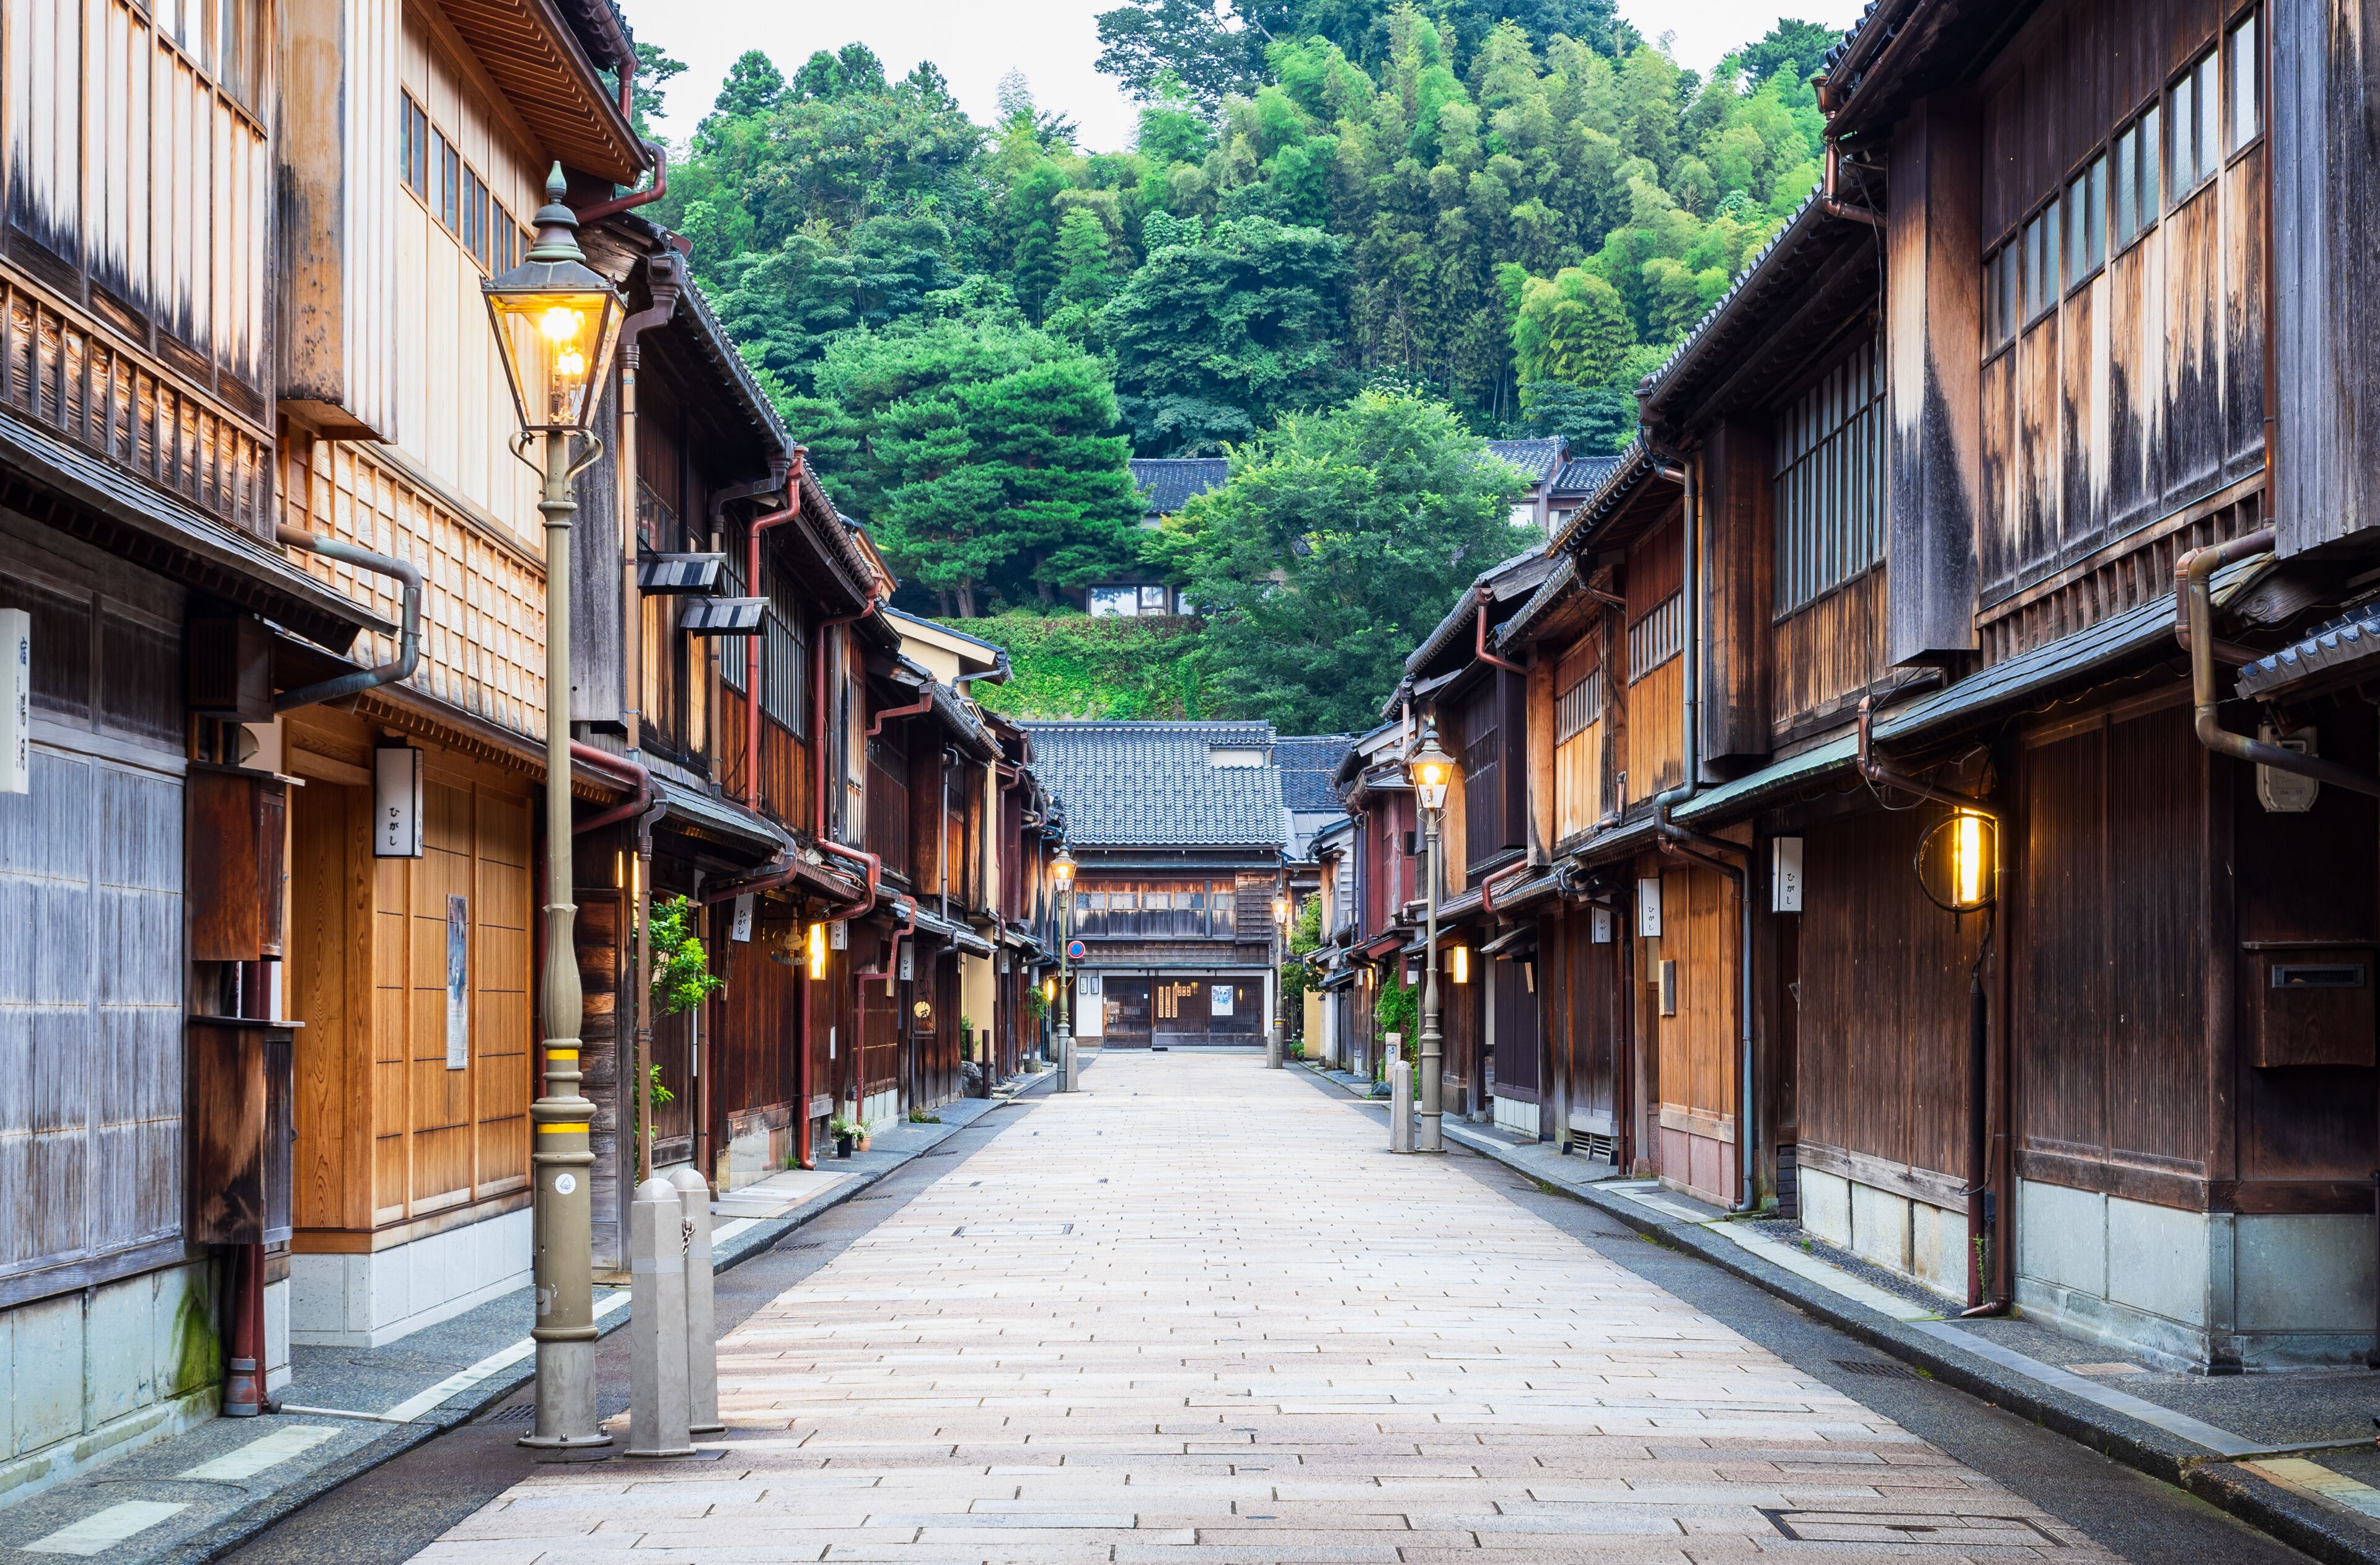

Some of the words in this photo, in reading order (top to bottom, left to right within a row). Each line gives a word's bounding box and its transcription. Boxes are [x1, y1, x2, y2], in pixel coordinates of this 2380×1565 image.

[389, 807, 400, 846] ひがし
[1786, 873, 1795, 905] ひがし
[737, 909, 747, 935] ひがし
